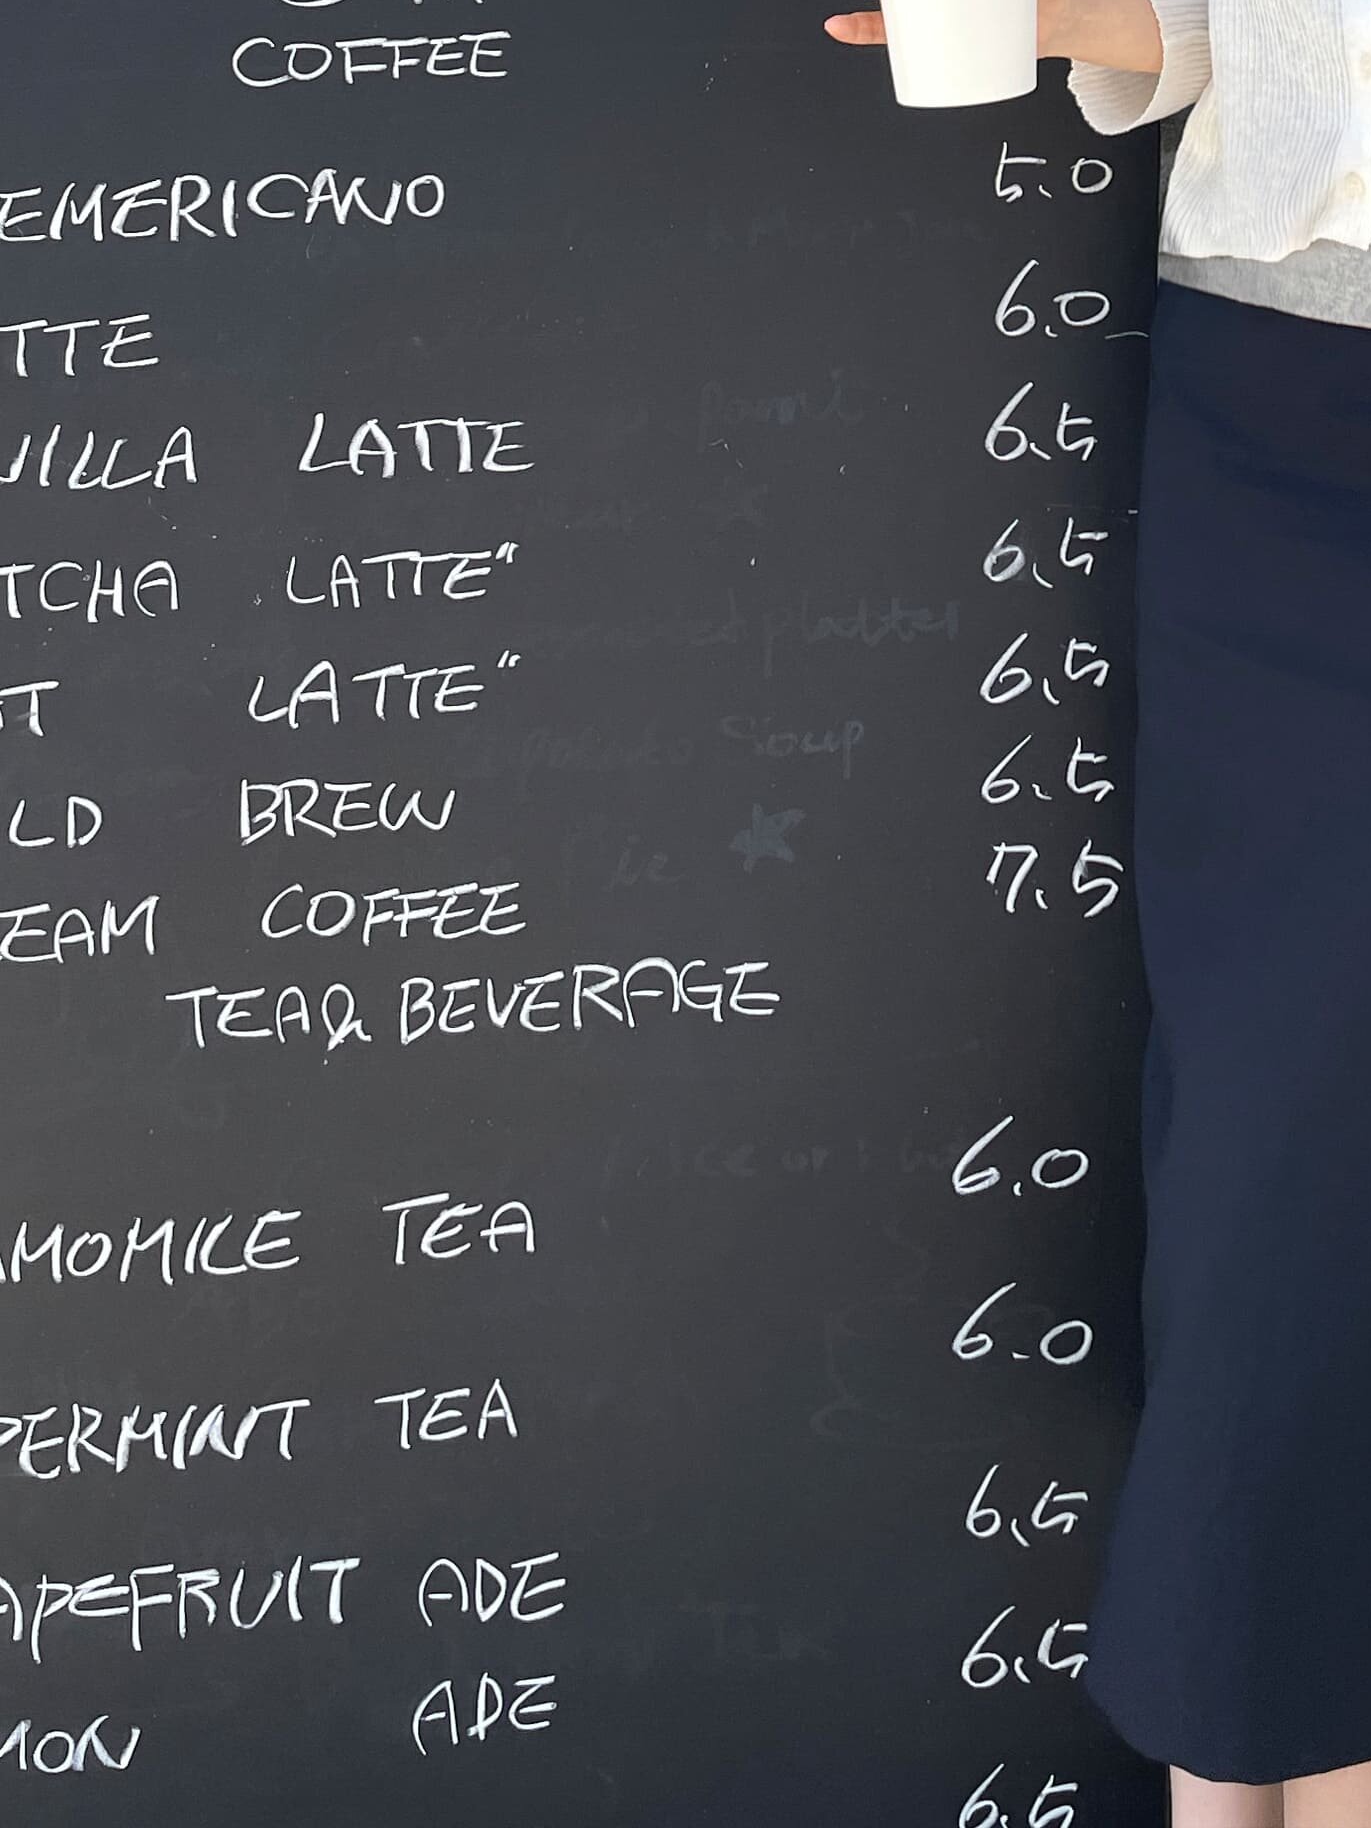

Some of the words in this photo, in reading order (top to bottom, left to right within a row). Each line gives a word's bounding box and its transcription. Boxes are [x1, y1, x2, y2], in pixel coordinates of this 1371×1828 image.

[231, 30, 512, 88] COFFEE
[994, 141, 1113, 203] 5.0
[994, 259, 1110, 338] 6.0
[0, 313, 159, 378] TTE
[298, 412, 535, 479] LATTE
[984, 381, 1098, 462] 6.5
[982, 516, 1109, 589] 6.5
[0, 559, 179, 623] TCHA
[979, 632, 1110, 706] 6.5
[980, 734, 1115, 804] 6.5
[8, 795, 103, 849] LD
[240, 778, 456, 847] BREW
[985, 838, 1124, 918] 7.5
[0, 895, 160, 964] EAM
[261, 882, 527, 947] COFFEE
[399, 956, 781, 1046] BEVERAGE
[951, 1115, 1089, 1197] 6.0
[381, 1192, 535, 1266] TEA
[951, 1282, 1093, 1365] 6.0
[373, 1378, 518, 1450] TEA
[965, 1464, 1089, 1548] 6.5
[418, 1551, 567, 1628] ADE
[961, 1605, 1089, 1689] 6.5
[412, 1671, 558, 1756] ADE
